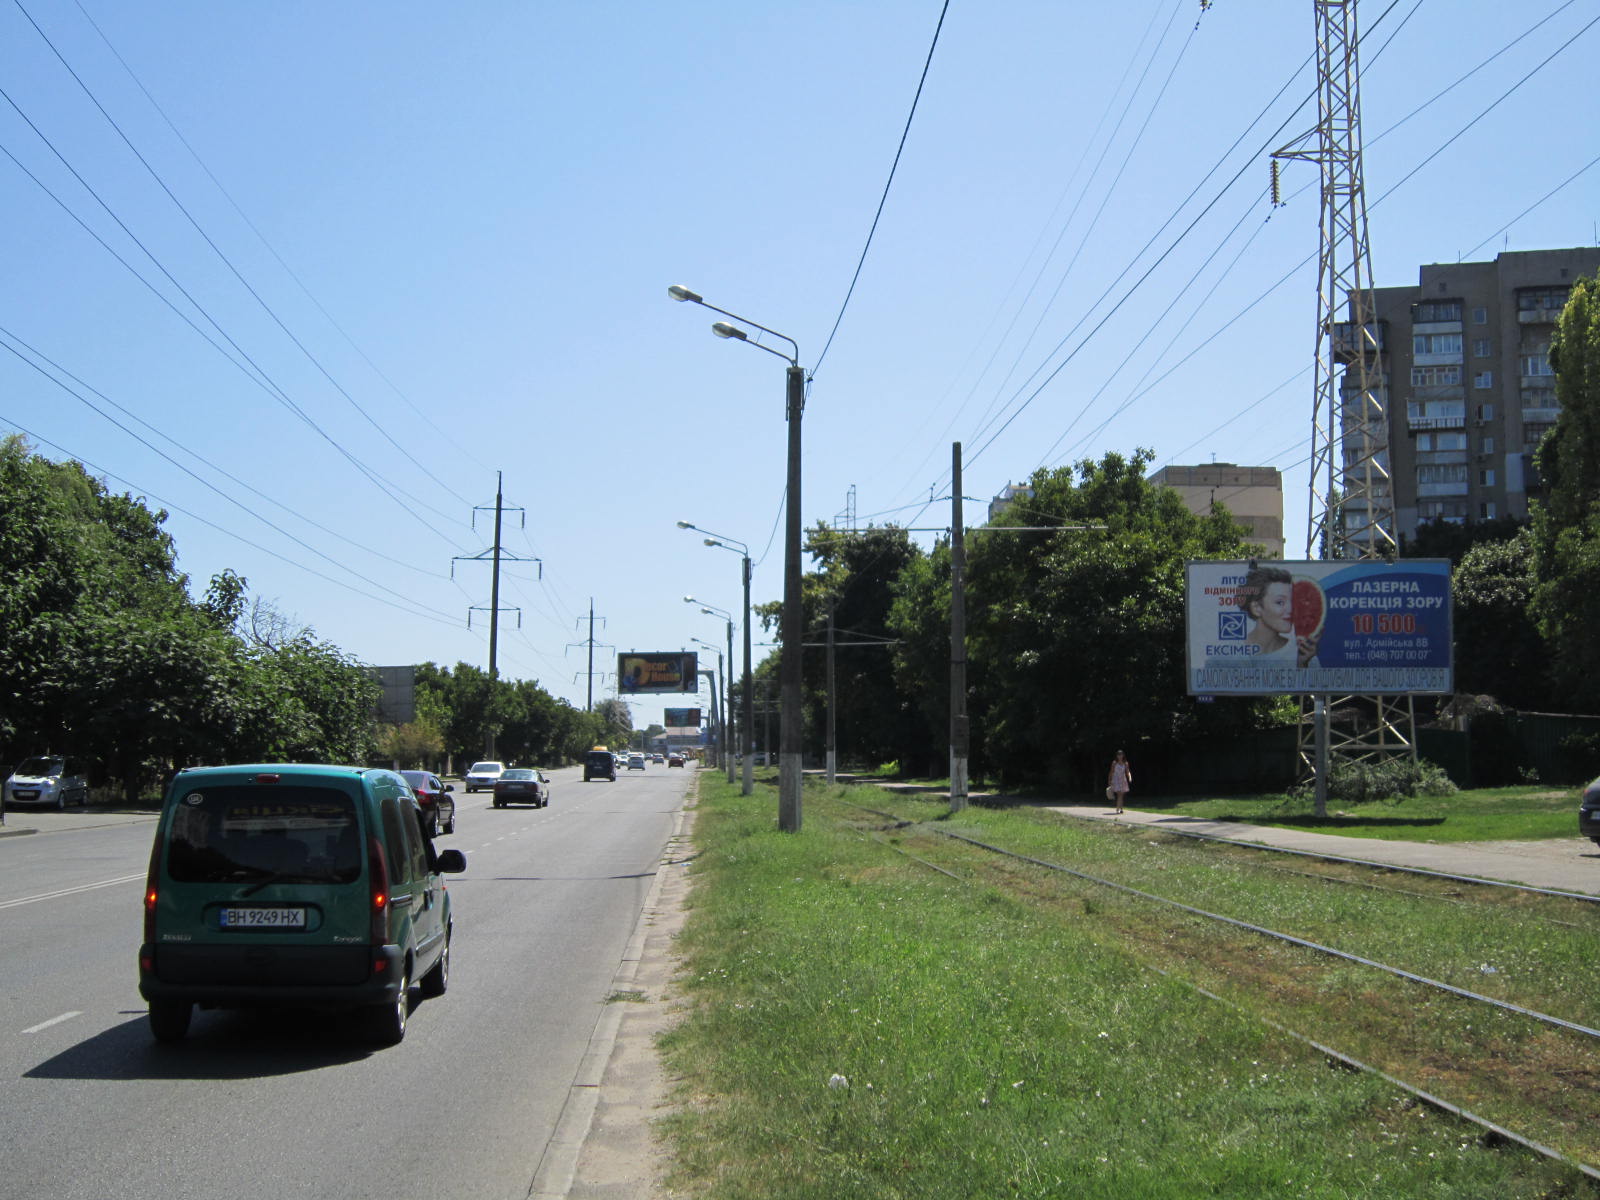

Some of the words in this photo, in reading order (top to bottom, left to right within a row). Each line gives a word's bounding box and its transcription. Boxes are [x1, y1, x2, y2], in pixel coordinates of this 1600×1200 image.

[1221, 576, 1247, 585] ЛІТО
[1352, 581, 1420, 593] ЛАЗЕРНА
[1329, 597, 1402, 611] КОРЕКЦІЯ
[1406, 597, 1443, 609] ЗОРУ
[1352, 614, 1374, 634] 10
[1378, 614, 1416, 634] 500
[1366, 638, 1414, 649] Армійська
[1206, 645, 1261, 656] ЕКСІМЕР
[227, 910, 246, 924] BH
[249, 910, 278, 924] 9249
[281, 910, 300, 924] HX
